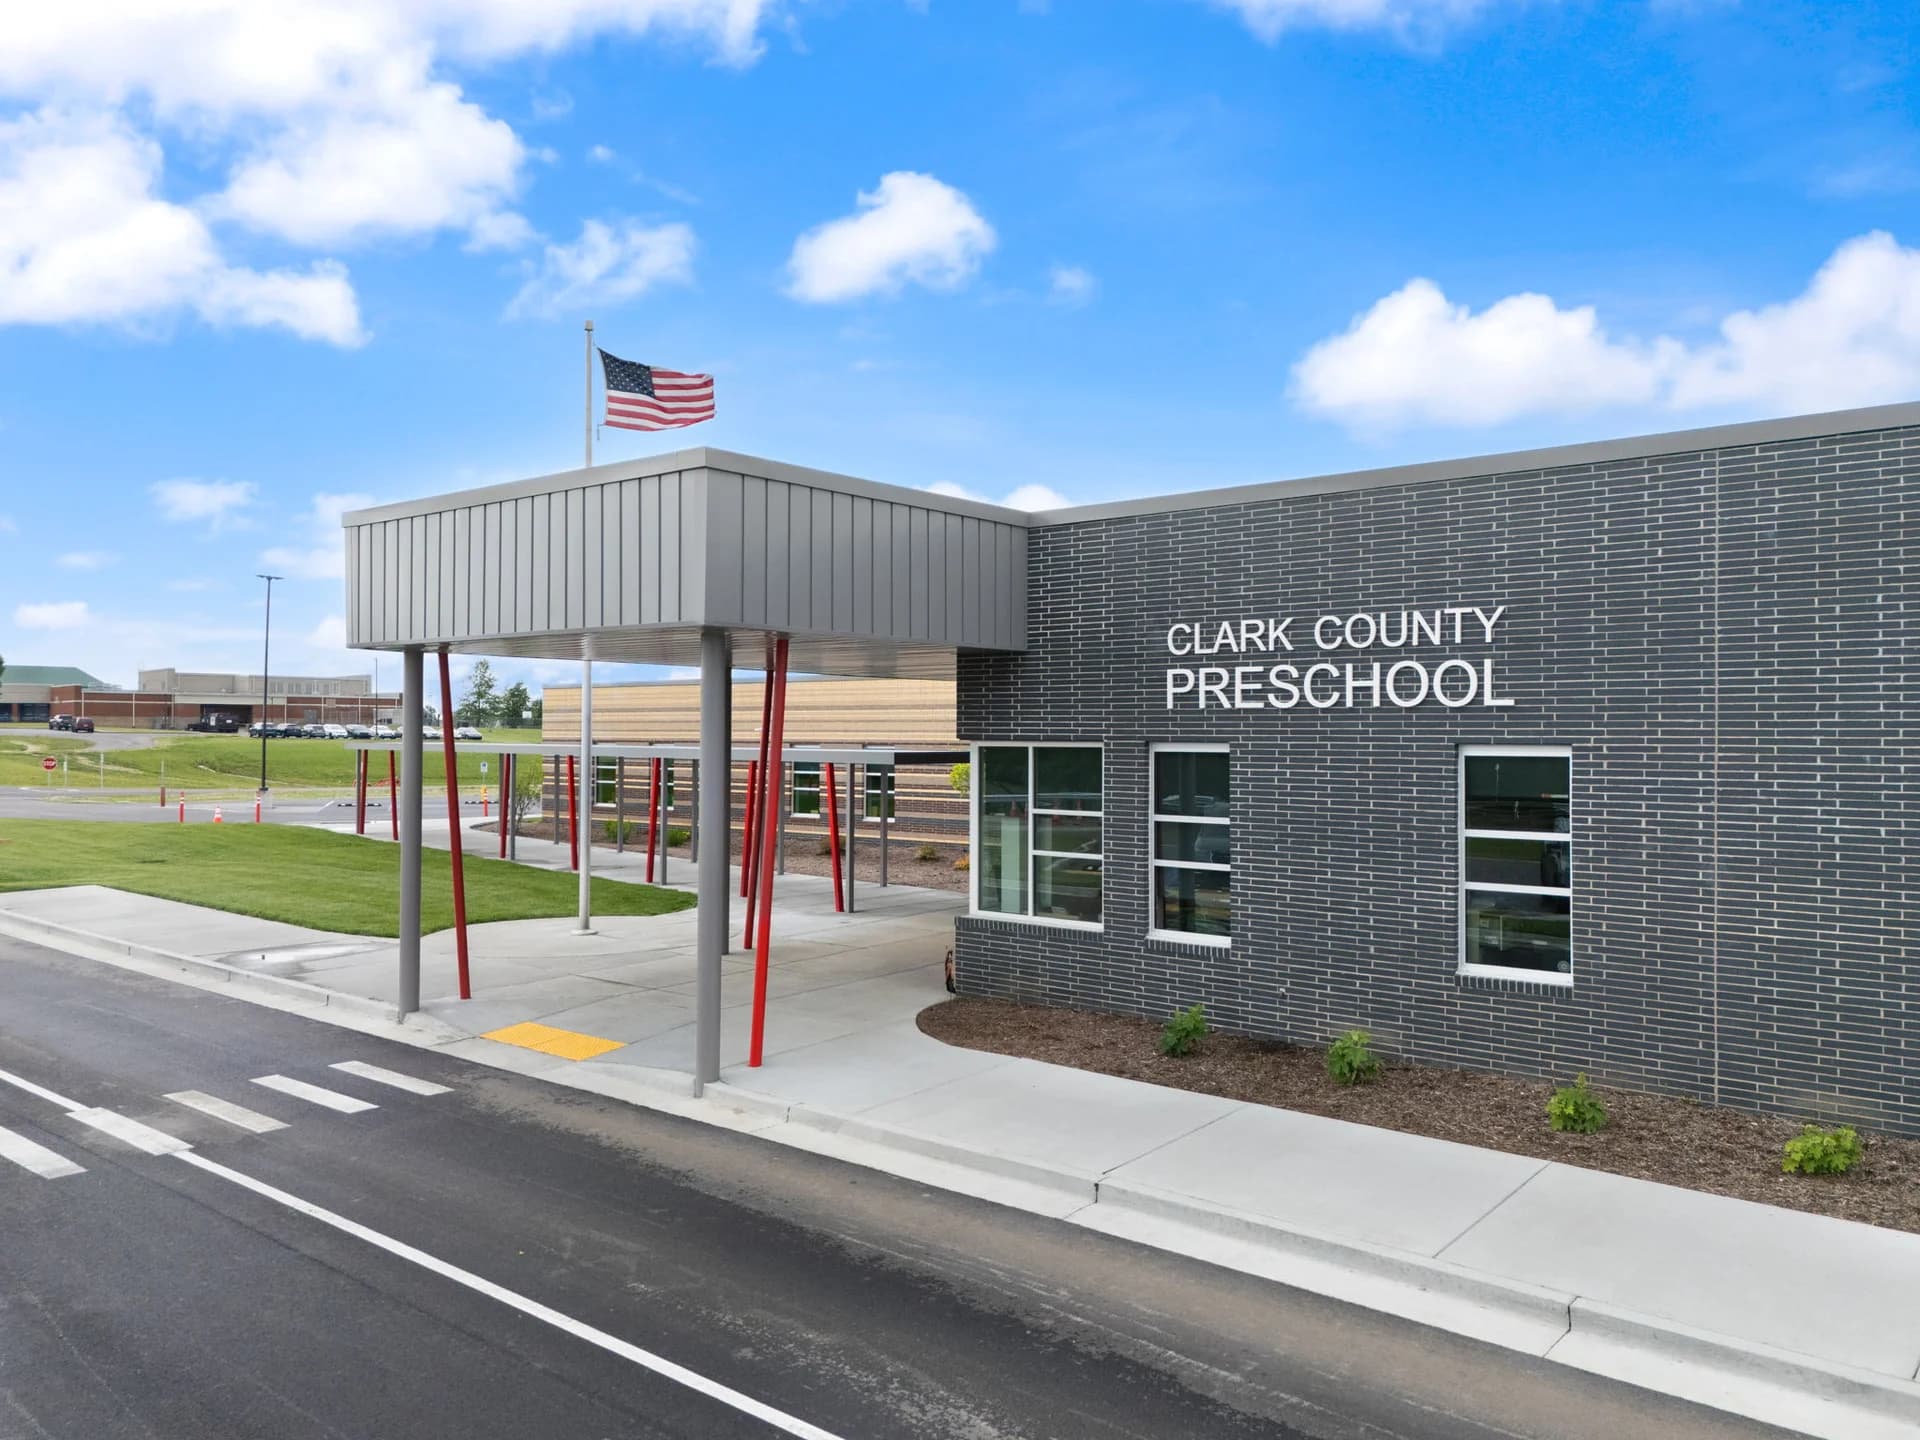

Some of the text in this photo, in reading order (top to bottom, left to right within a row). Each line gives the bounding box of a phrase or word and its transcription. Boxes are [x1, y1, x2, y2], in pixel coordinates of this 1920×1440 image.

[1167, 605, 1505, 656] CLARK COUNTY
[1166, 658, 1515, 709] PRESCHOOL
